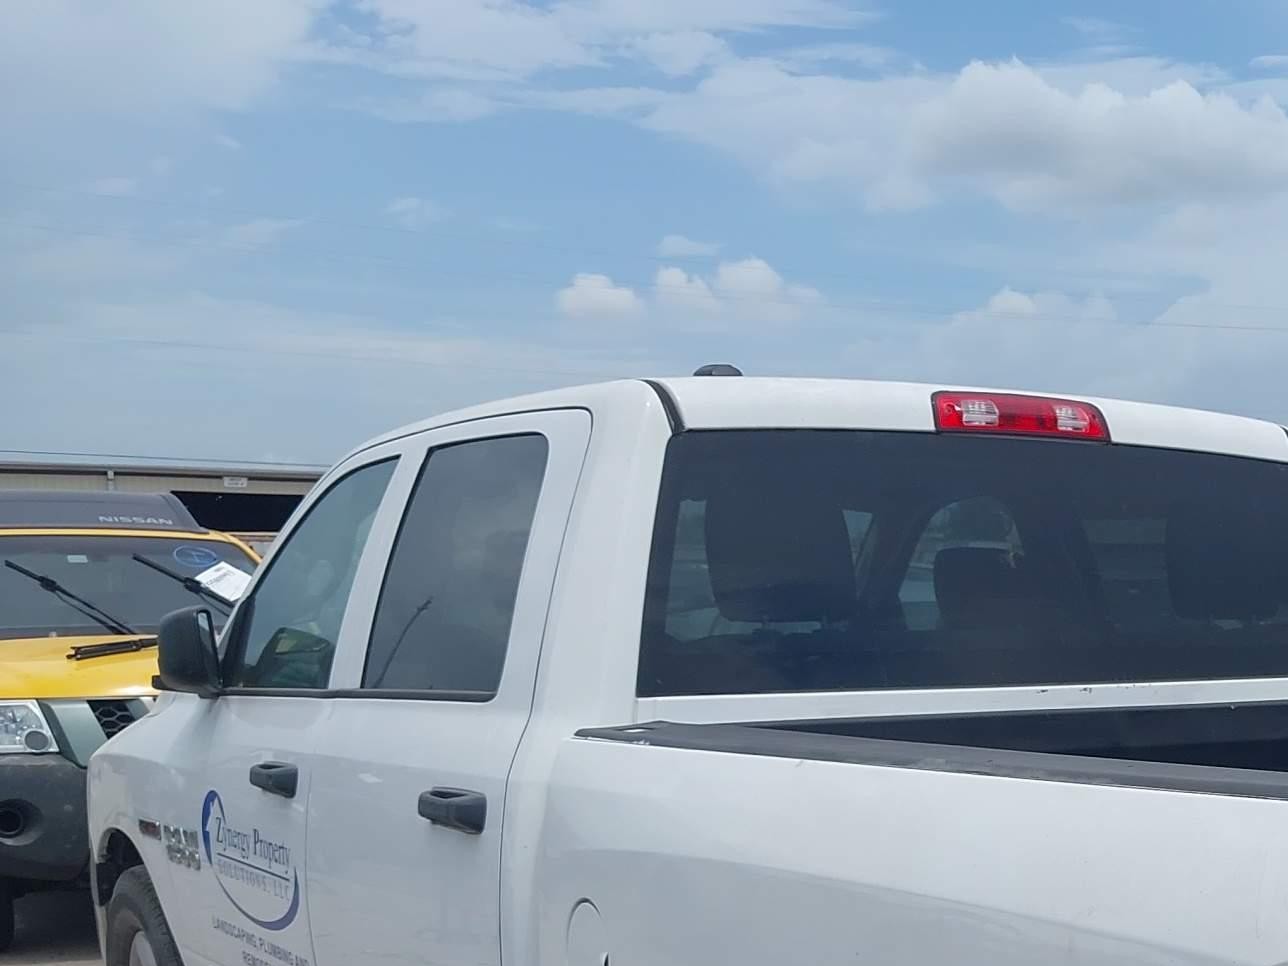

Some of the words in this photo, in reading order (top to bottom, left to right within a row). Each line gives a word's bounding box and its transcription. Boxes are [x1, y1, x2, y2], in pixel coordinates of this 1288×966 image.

[98, 515, 173, 525] NISSAN
[216, 816, 251, 861] Zynergy
[253, 828, 291, 876] Property
[258, 937, 294, 966] PLUMBING
